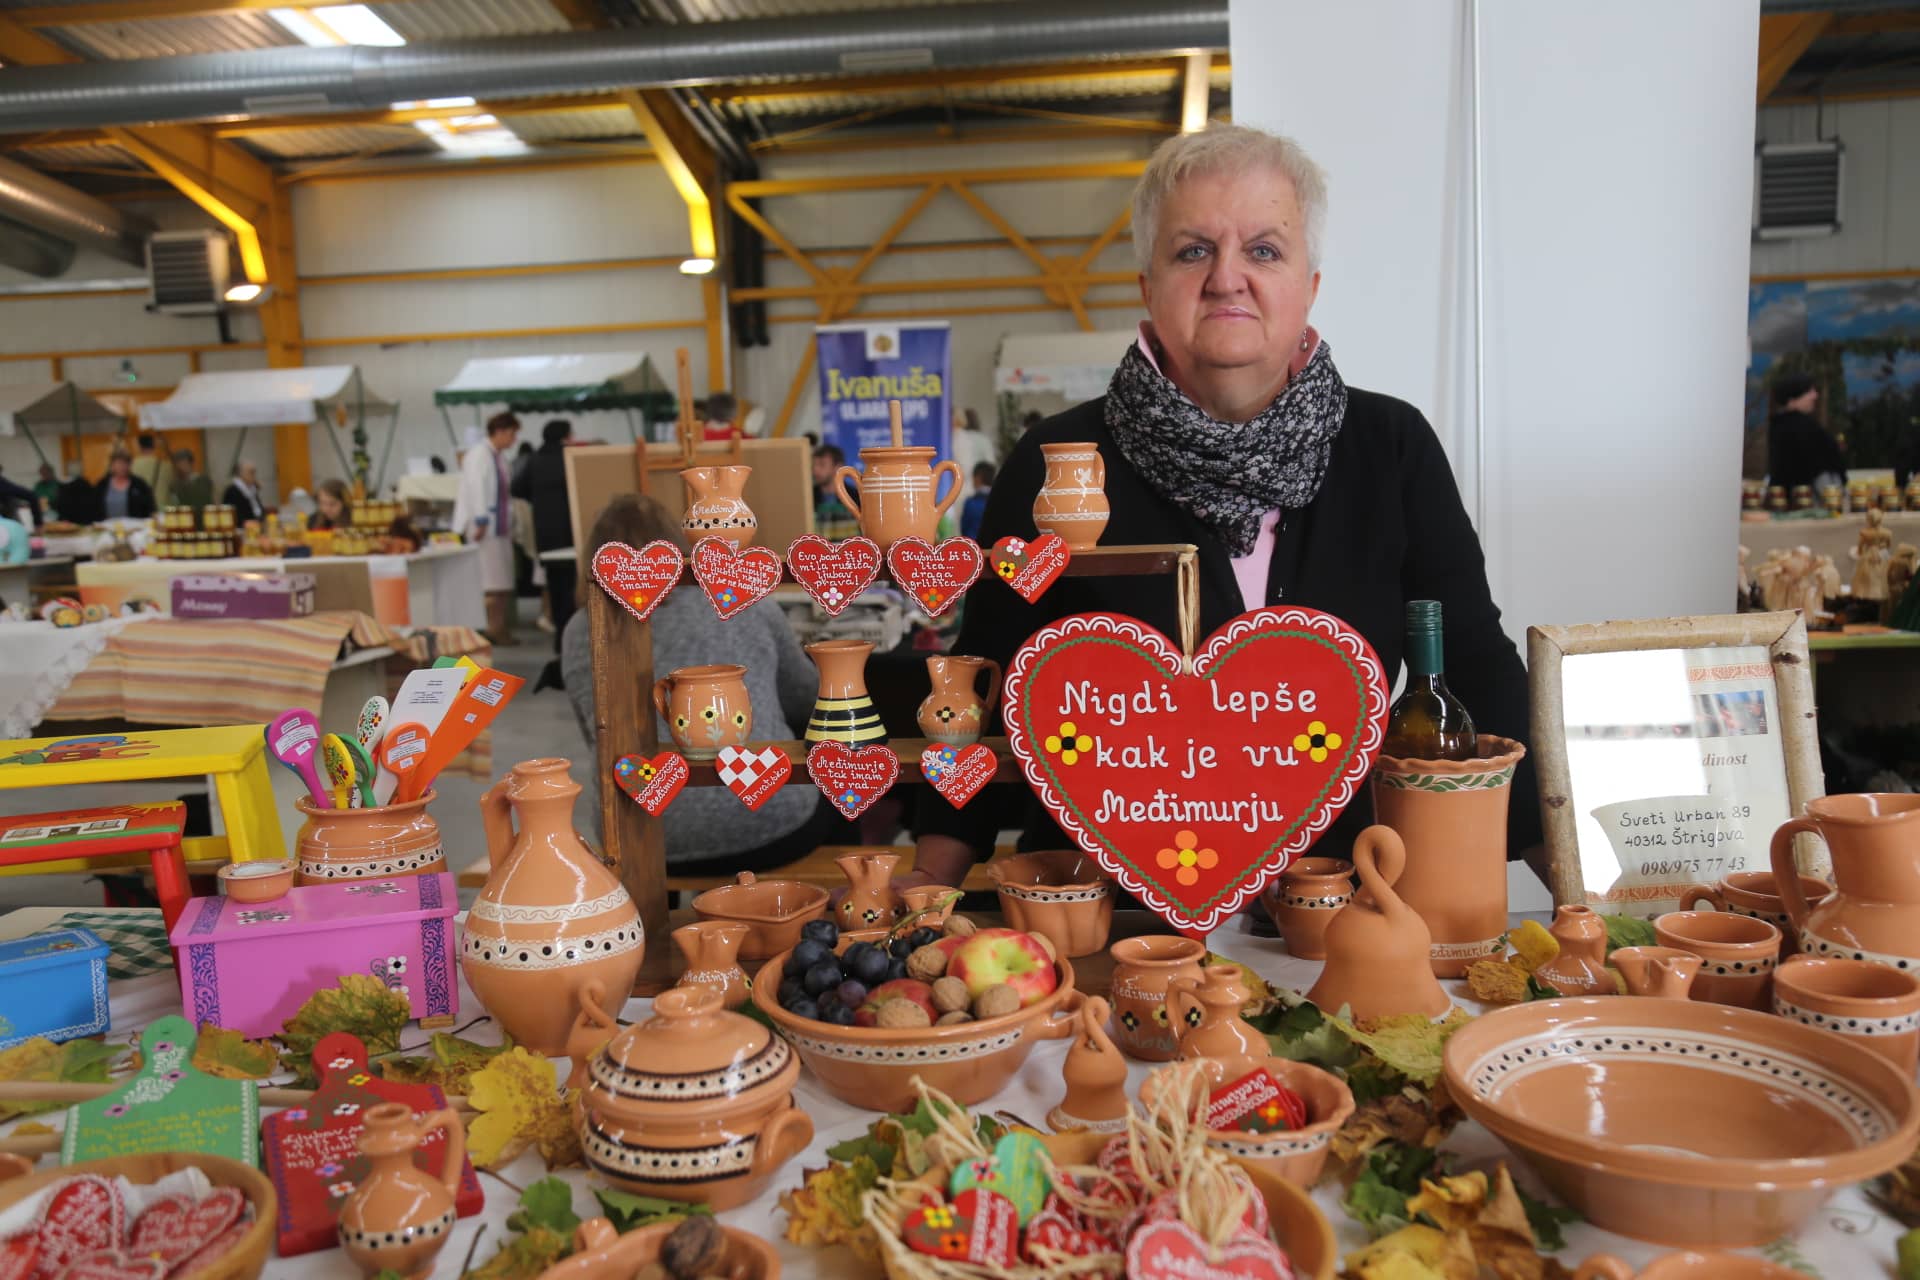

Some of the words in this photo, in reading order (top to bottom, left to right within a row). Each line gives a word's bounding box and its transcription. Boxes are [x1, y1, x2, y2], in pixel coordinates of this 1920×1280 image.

[827, 367, 942, 400] Ivanuša
[798, 552, 816, 561] Evo
[819, 553, 841, 563] sam
[949, 551, 960, 560] bi
[962, 551, 972, 560] ti
[800, 560, 828, 571] mila
[911, 567, 953, 580] draga
[1058, 680, 1178, 726] Nigdi
[1210, 678, 1318, 723] lepše
[816, 755, 885, 773] Međimurje
[1094, 735, 1169, 768] kak
[1181, 739, 1218, 779] je
[1242, 745, 1299, 767] vu
[1702, 752, 1748, 767] dinost
[832, 779, 845, 789] te
[850, 770, 883, 780] imam
[742, 767, 788, 806] Hrvatska
[1094, 788, 1284, 833] Međimurju
[1619, 811, 1666, 828] Sveti
[1674, 809, 1726, 825] Urban
[1624, 833, 1667, 848] 40312
[1671, 827, 1745, 848] Štrigova
[1640, 859, 1700, 877] 098/975
[1703, 857, 1724, 872] 77
[1727, 856, 1746, 871] 43
[1431, 942, 1489, 958] eđimurje
